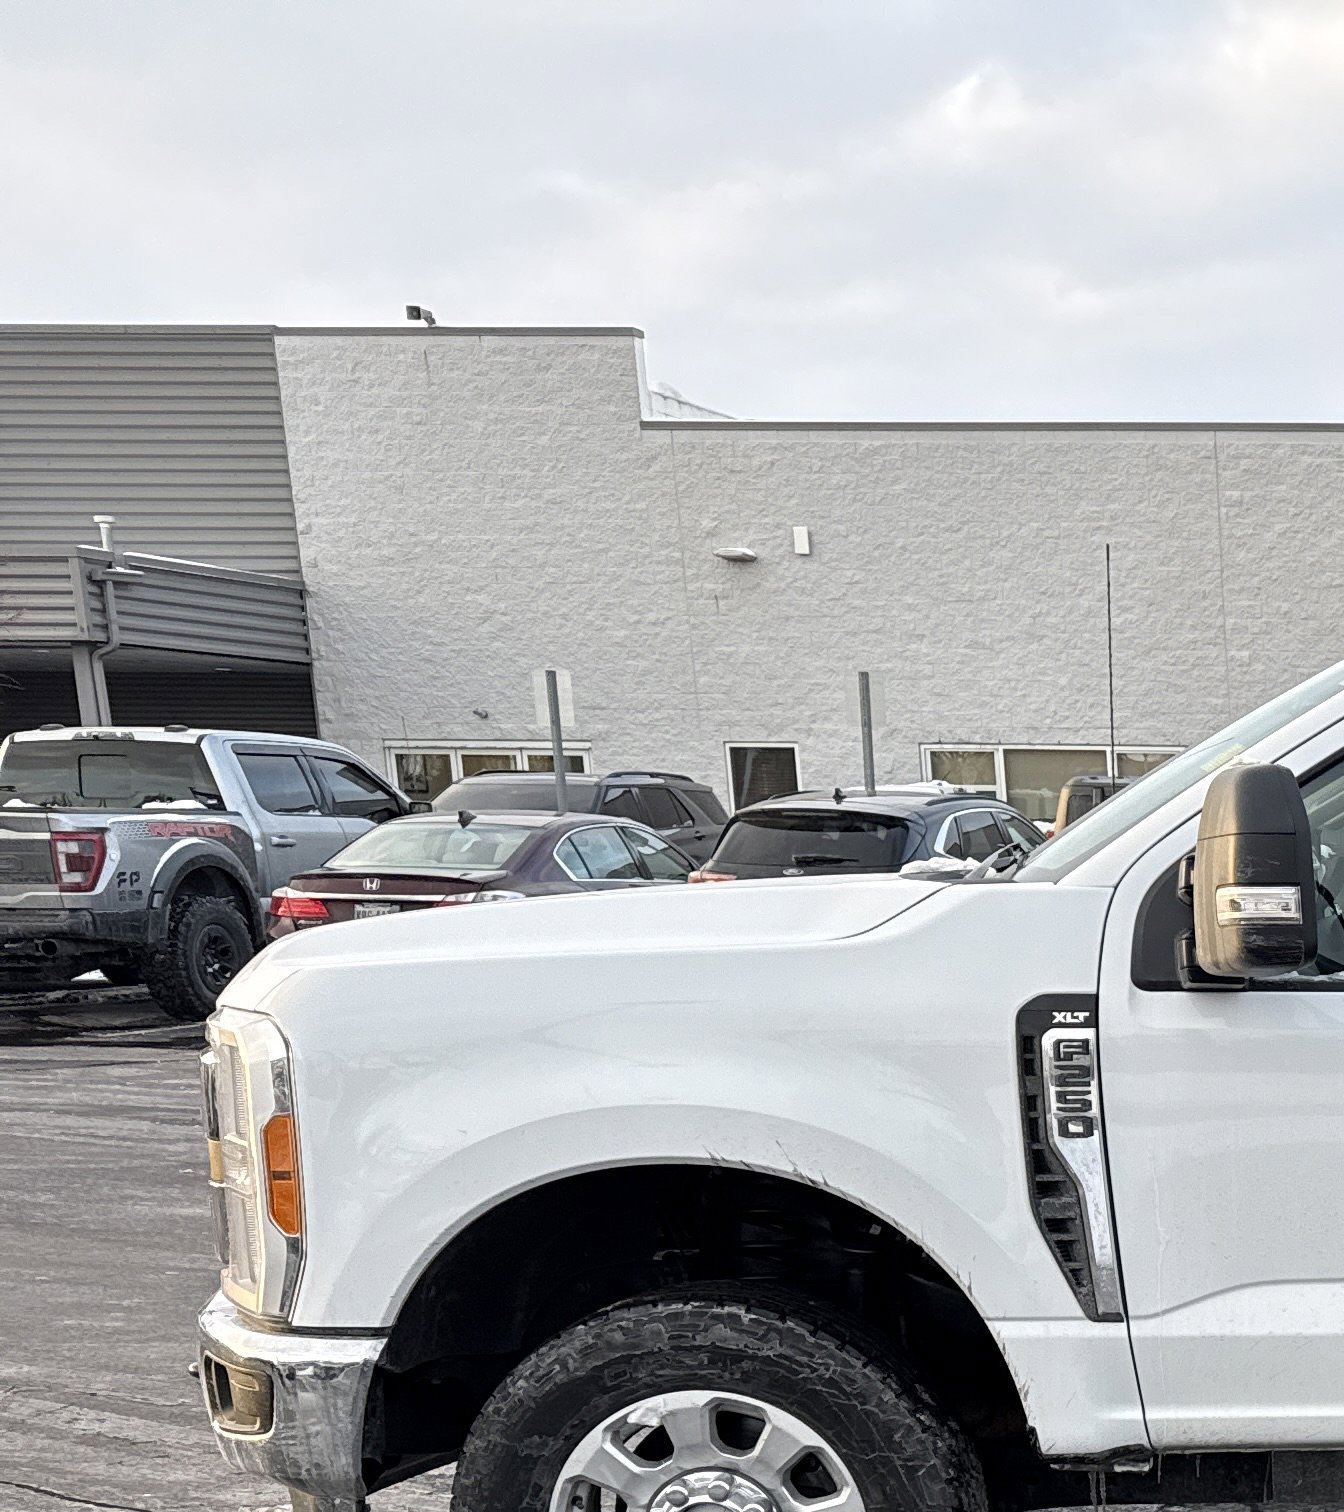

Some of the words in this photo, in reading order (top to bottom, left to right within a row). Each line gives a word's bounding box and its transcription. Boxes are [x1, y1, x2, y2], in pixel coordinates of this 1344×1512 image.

[147, 822, 235, 843] RAPTOR
[1052, 1011, 1090, 1023] XLT
[1053, 1038, 1094, 1138] F250
